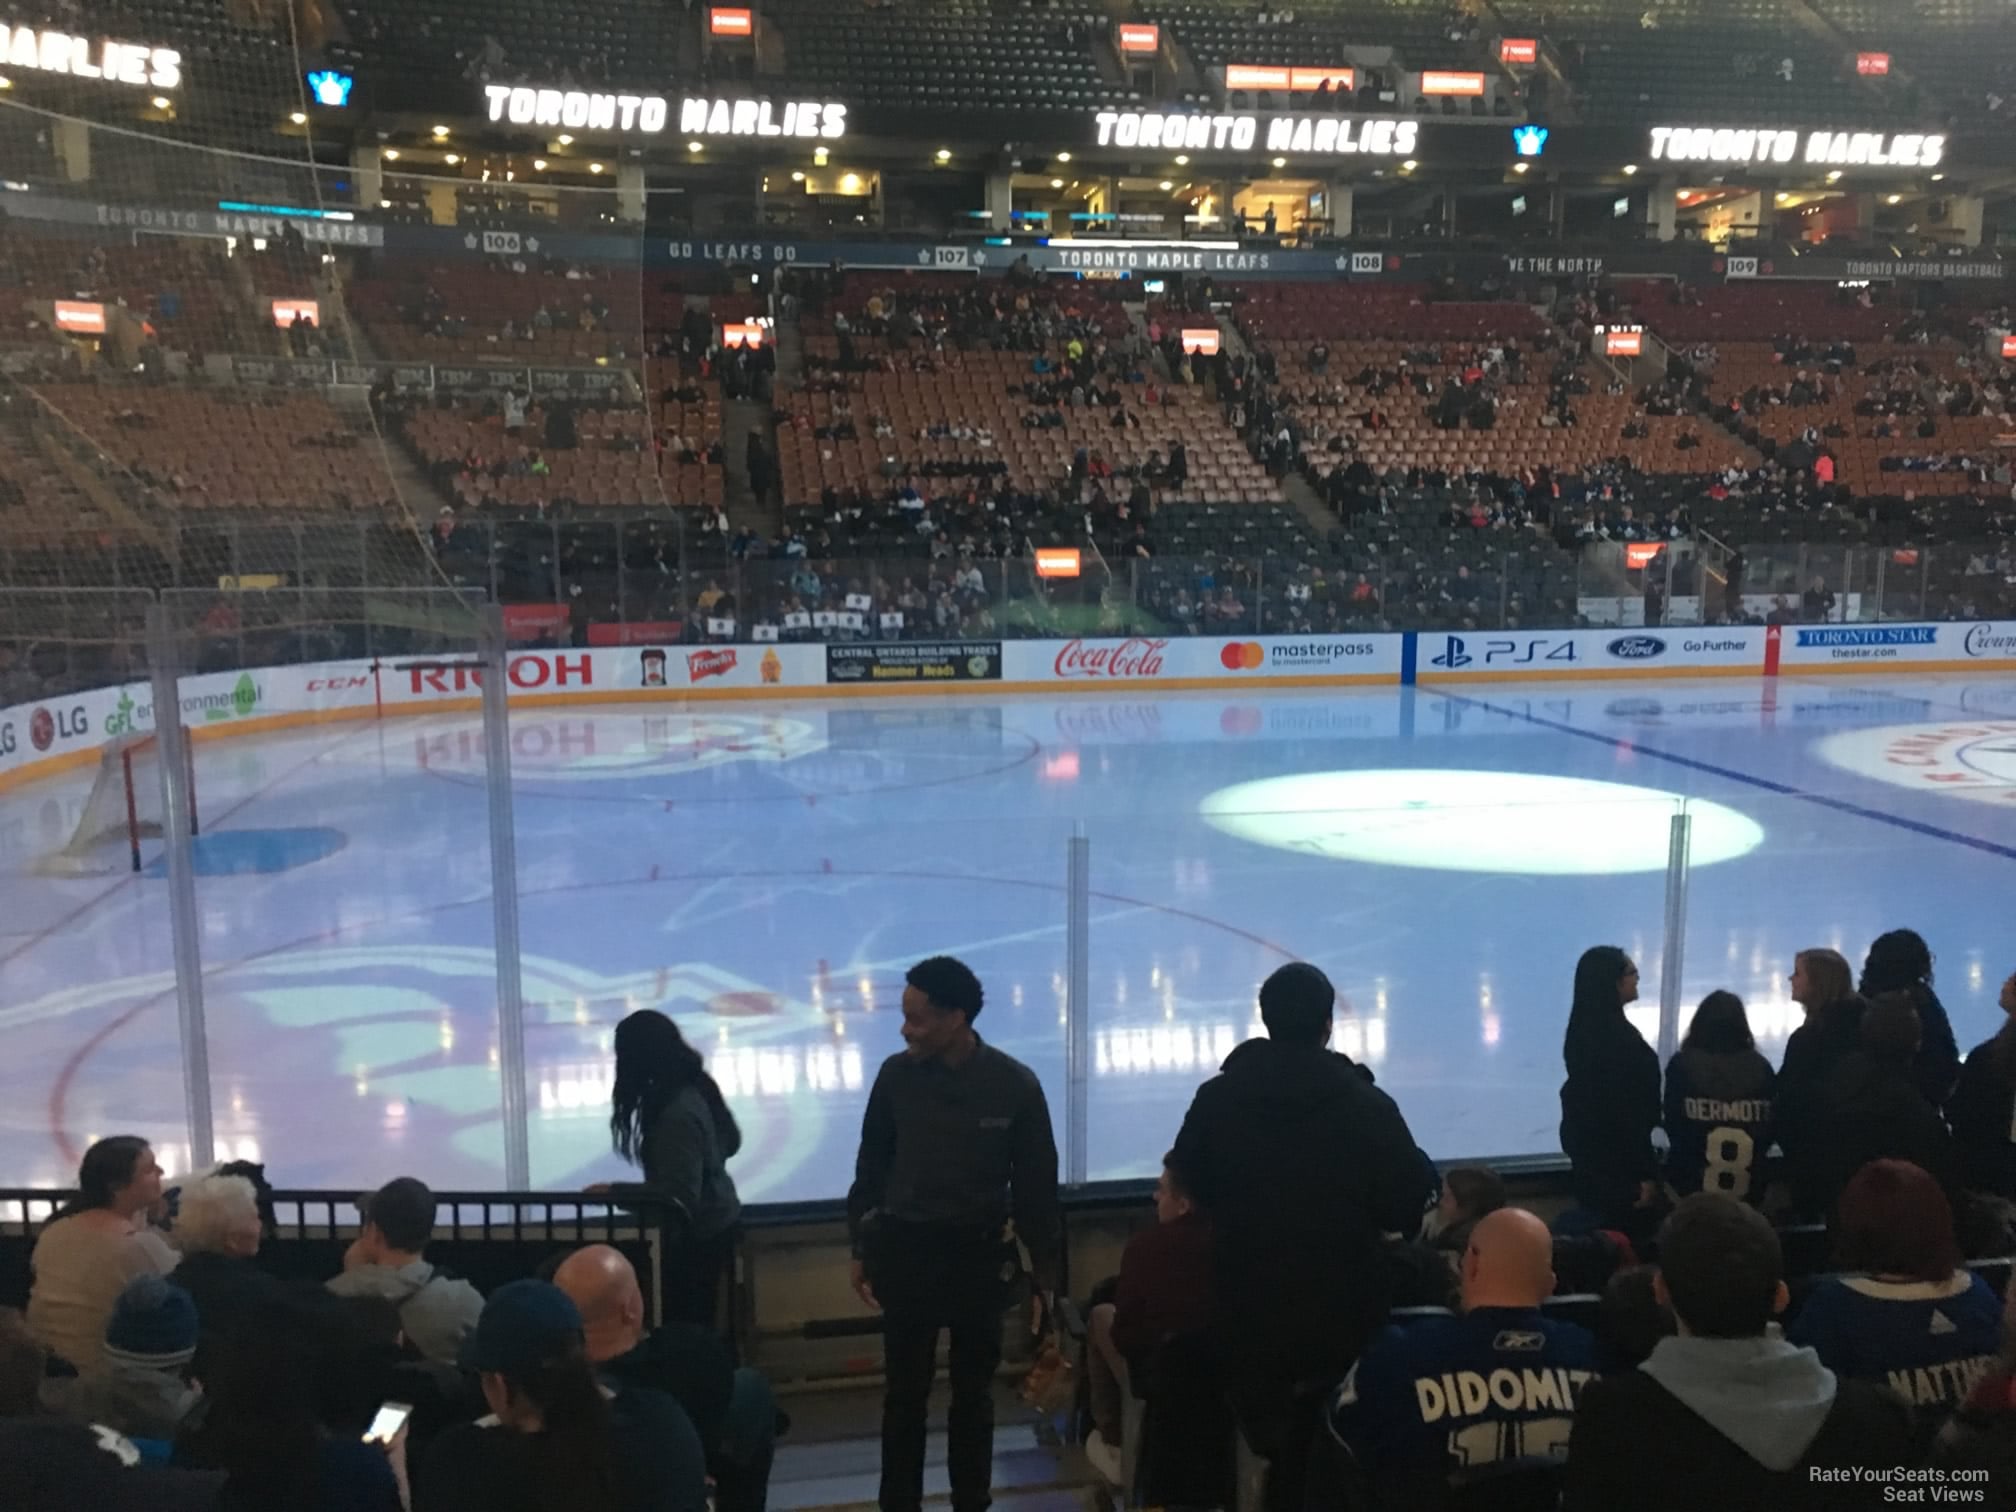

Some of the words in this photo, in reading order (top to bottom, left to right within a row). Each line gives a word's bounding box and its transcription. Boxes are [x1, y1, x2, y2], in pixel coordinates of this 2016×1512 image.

[485, 85, 667, 132] TORONTO
[681, 98, 847, 138] MARLIES
[1096, 112, 1256, 150] TORONTO
[1267, 117, 1418, 153] MARLIES
[1650, 127, 1798, 162] TORONTO
[1805, 131, 1945, 166] MARLIES
[303, 220, 369, 243] LEAFS
[485, 233, 518, 250] 106
[669, 242, 692, 258] GO
[703, 244, 762, 260] LEAFS
[773, 245, 796, 261] GO
[937, 249, 965, 264] 107
[1060, 251, 1138, 268] TORONTO
[1146, 253, 1202, 269] MAPLE
[1216, 255, 1269, 270] LEAFS
[1355, 255, 1380, 269] 108
[1528, 257, 1553, 273] THE
[1557, 257, 1603, 273] NORTH
[1730, 258, 1755, 274] 109
[1846, 262, 1892, 275] TORONTO
[1896, 263, 1939, 276] RAPTORS
[1806, 629, 1884, 645] TORONTO
[1887, 627, 1929, 643] STAR
[832, 647, 874, 658] CENTRAL
[876, 647, 915, 657] ONTARIO
[963, 645, 998, 656] TRADES
[1272, 643, 1374, 659] masterpass
[1486, 641, 1576, 663] PS4
[1617, 638, 1656, 656] Ford
[1684, 640, 1700, 652] Go
[1703, 640, 1747, 651] Further
[1832, 647, 1897, 658] thestar.com
[872, 665, 917, 677] Hammer
[923, 664, 955, 677] Heads
[305, 677, 369, 692] CCM
[105, 712, 136, 736] GFL
[136, 685, 262, 719] enonmental
[58, 706, 88, 738] LG
[1703, 1126, 1754, 1197] 8
